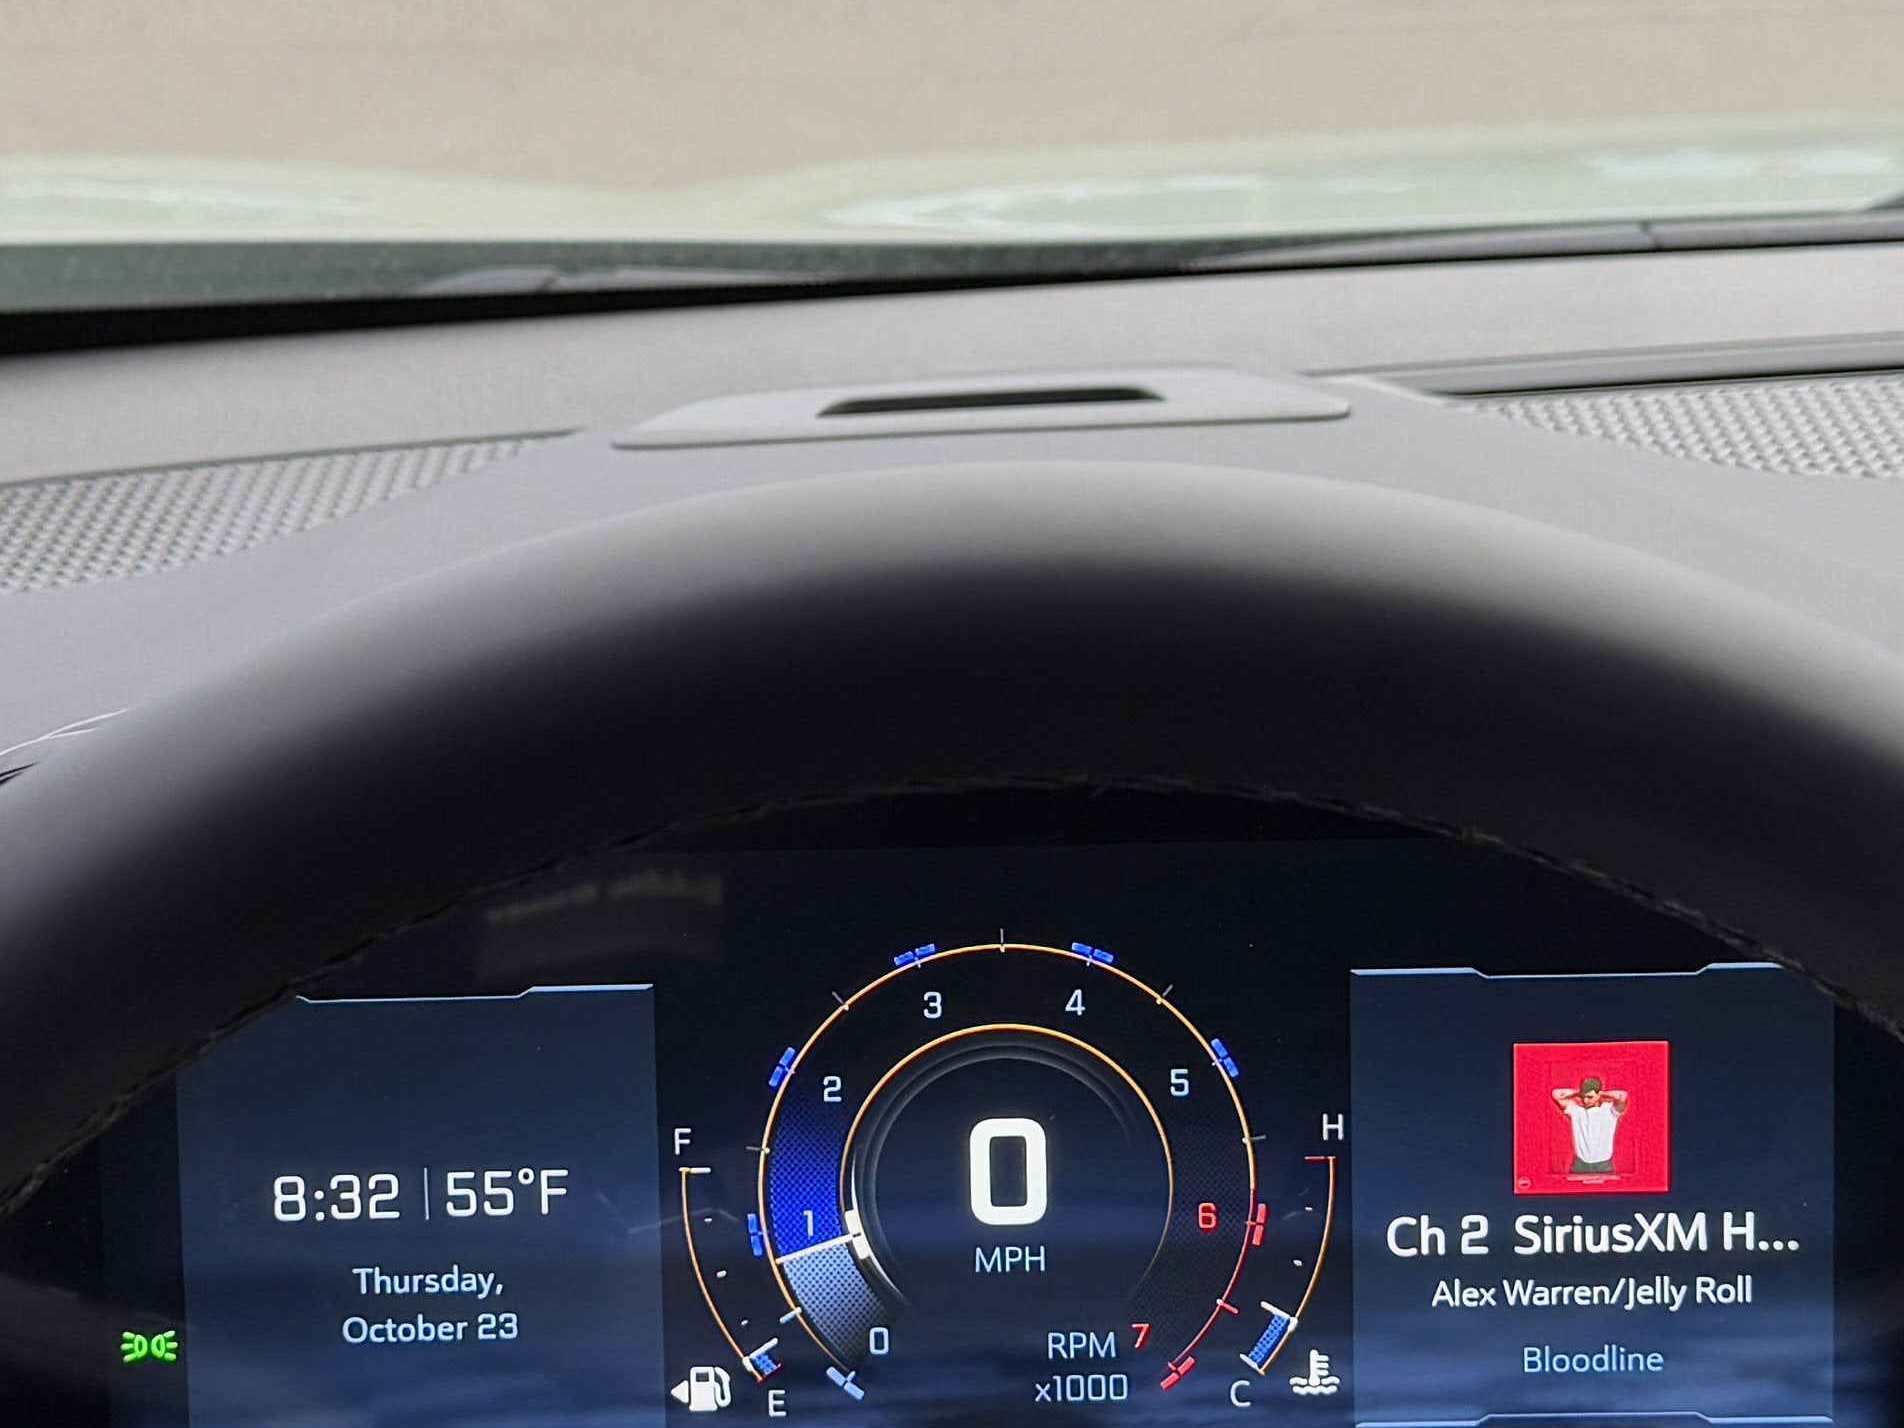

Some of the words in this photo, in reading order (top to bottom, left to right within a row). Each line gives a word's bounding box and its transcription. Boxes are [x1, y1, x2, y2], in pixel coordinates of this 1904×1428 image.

[922, 991, 943, 1020] 3
[1064, 988, 1086, 1016] 4
[822, 1075, 842, 1103] 2
[1169, 1068, 1190, 1097] 5
[1322, 1113, 1343, 1141] H
[673, 1127, 692, 1156] F
[968, 1117, 1048, 1226] 0
[272, 1173, 400, 1222] 8:32
[445, 1167, 569, 1216] 55°F
[802, 1209, 815, 1237] 1
[1197, 1202, 1217, 1229] 6
[1386, 1215, 1446, 1257] Ch
[1460, 1214, 1489, 1255] 2
[1514, 1211, 1708, 1255] SiriusXM
[974, 1245, 1046, 1273] MPH
[352, 1265, 504, 1298] Thursday,
[1431, 1279, 1497, 1308] Alex
[1502, 1274, 1688, 1311] Warren/Jelly
[1695, 1275, 1752, 1304] Roll
[342, 1315, 468, 1344] October
[477, 1312, 519, 1341] 23
[869, 1327, 889, 1356] 0
[1131, 1323, 1151, 1349] 7
[1046, 1331, 1117, 1359] RPM
[1522, 1345, 1665, 1373] Bloodline
[1034, 1373, 1128, 1403] x1000
[1230, 1380, 1251, 1407] C
[768, 1389, 786, 1417] E
